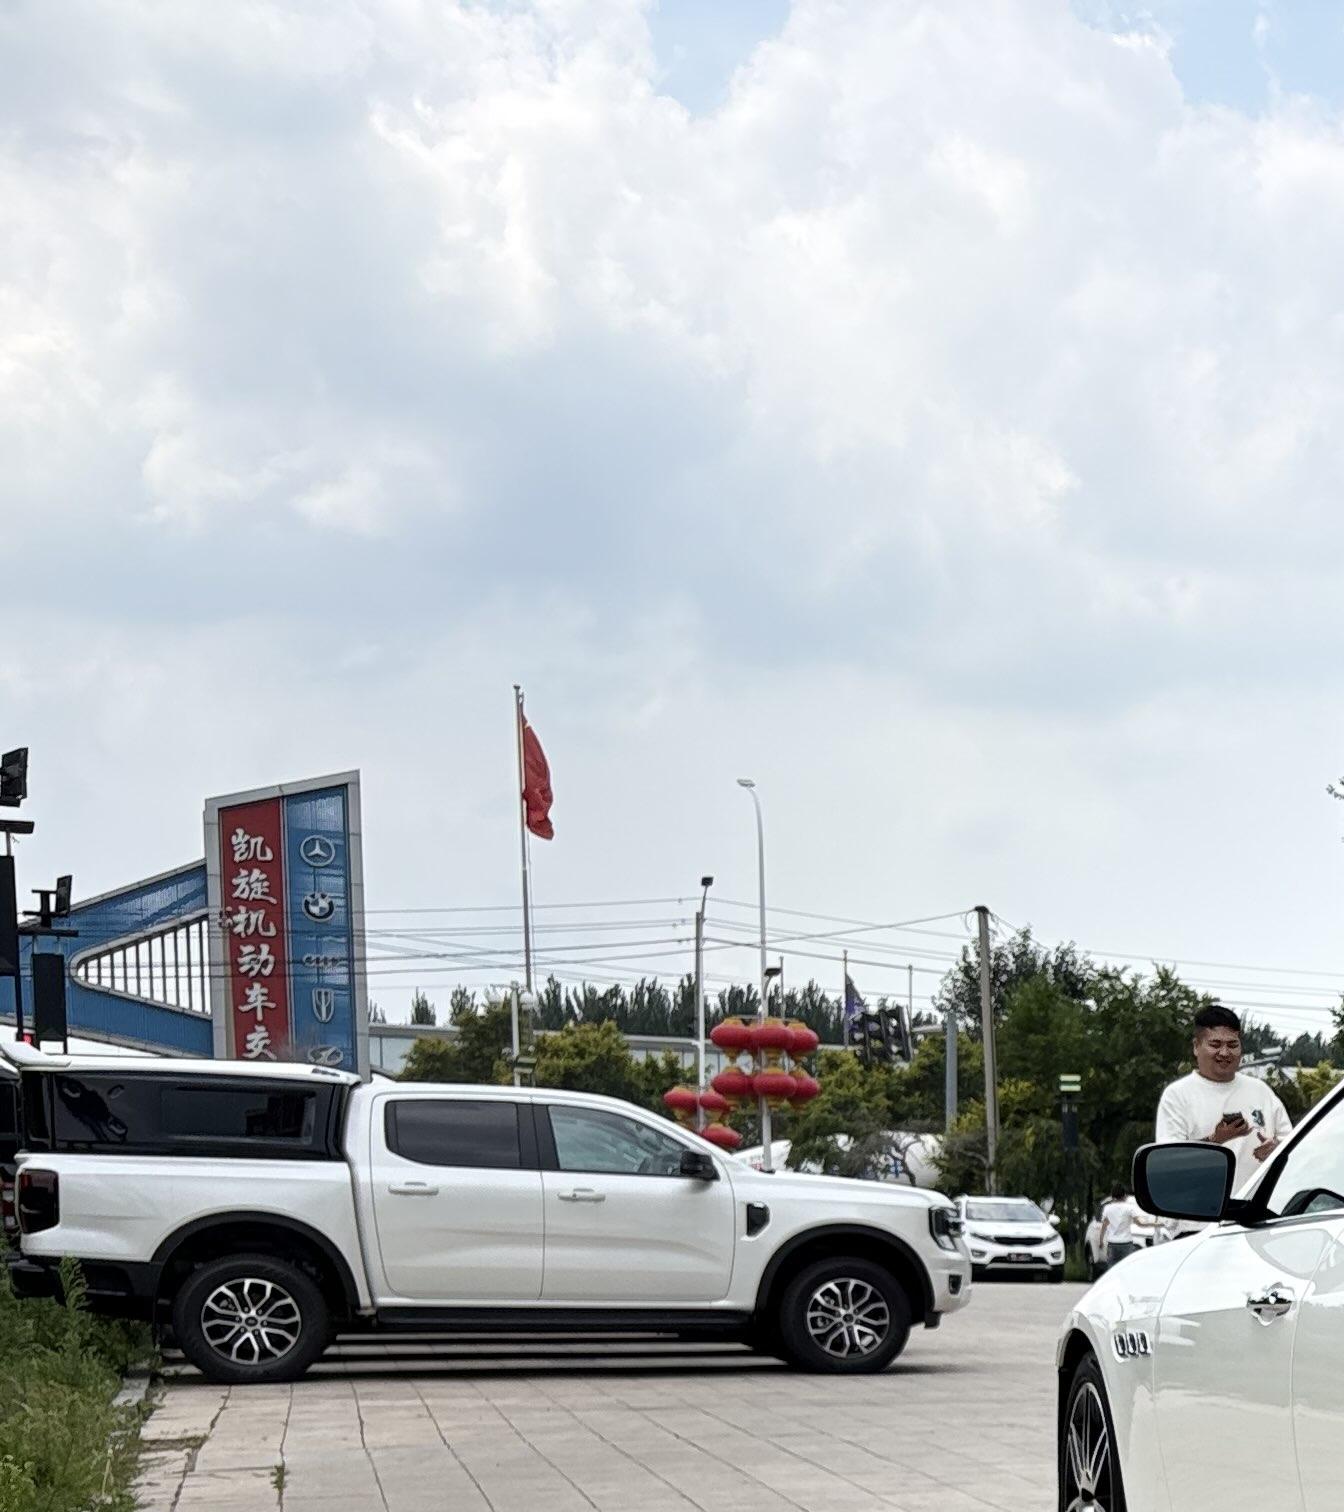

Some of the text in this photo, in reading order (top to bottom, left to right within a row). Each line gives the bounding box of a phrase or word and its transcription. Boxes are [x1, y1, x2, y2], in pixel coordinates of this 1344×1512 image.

[231, 828, 278, 1061] 凯旋机动车交
